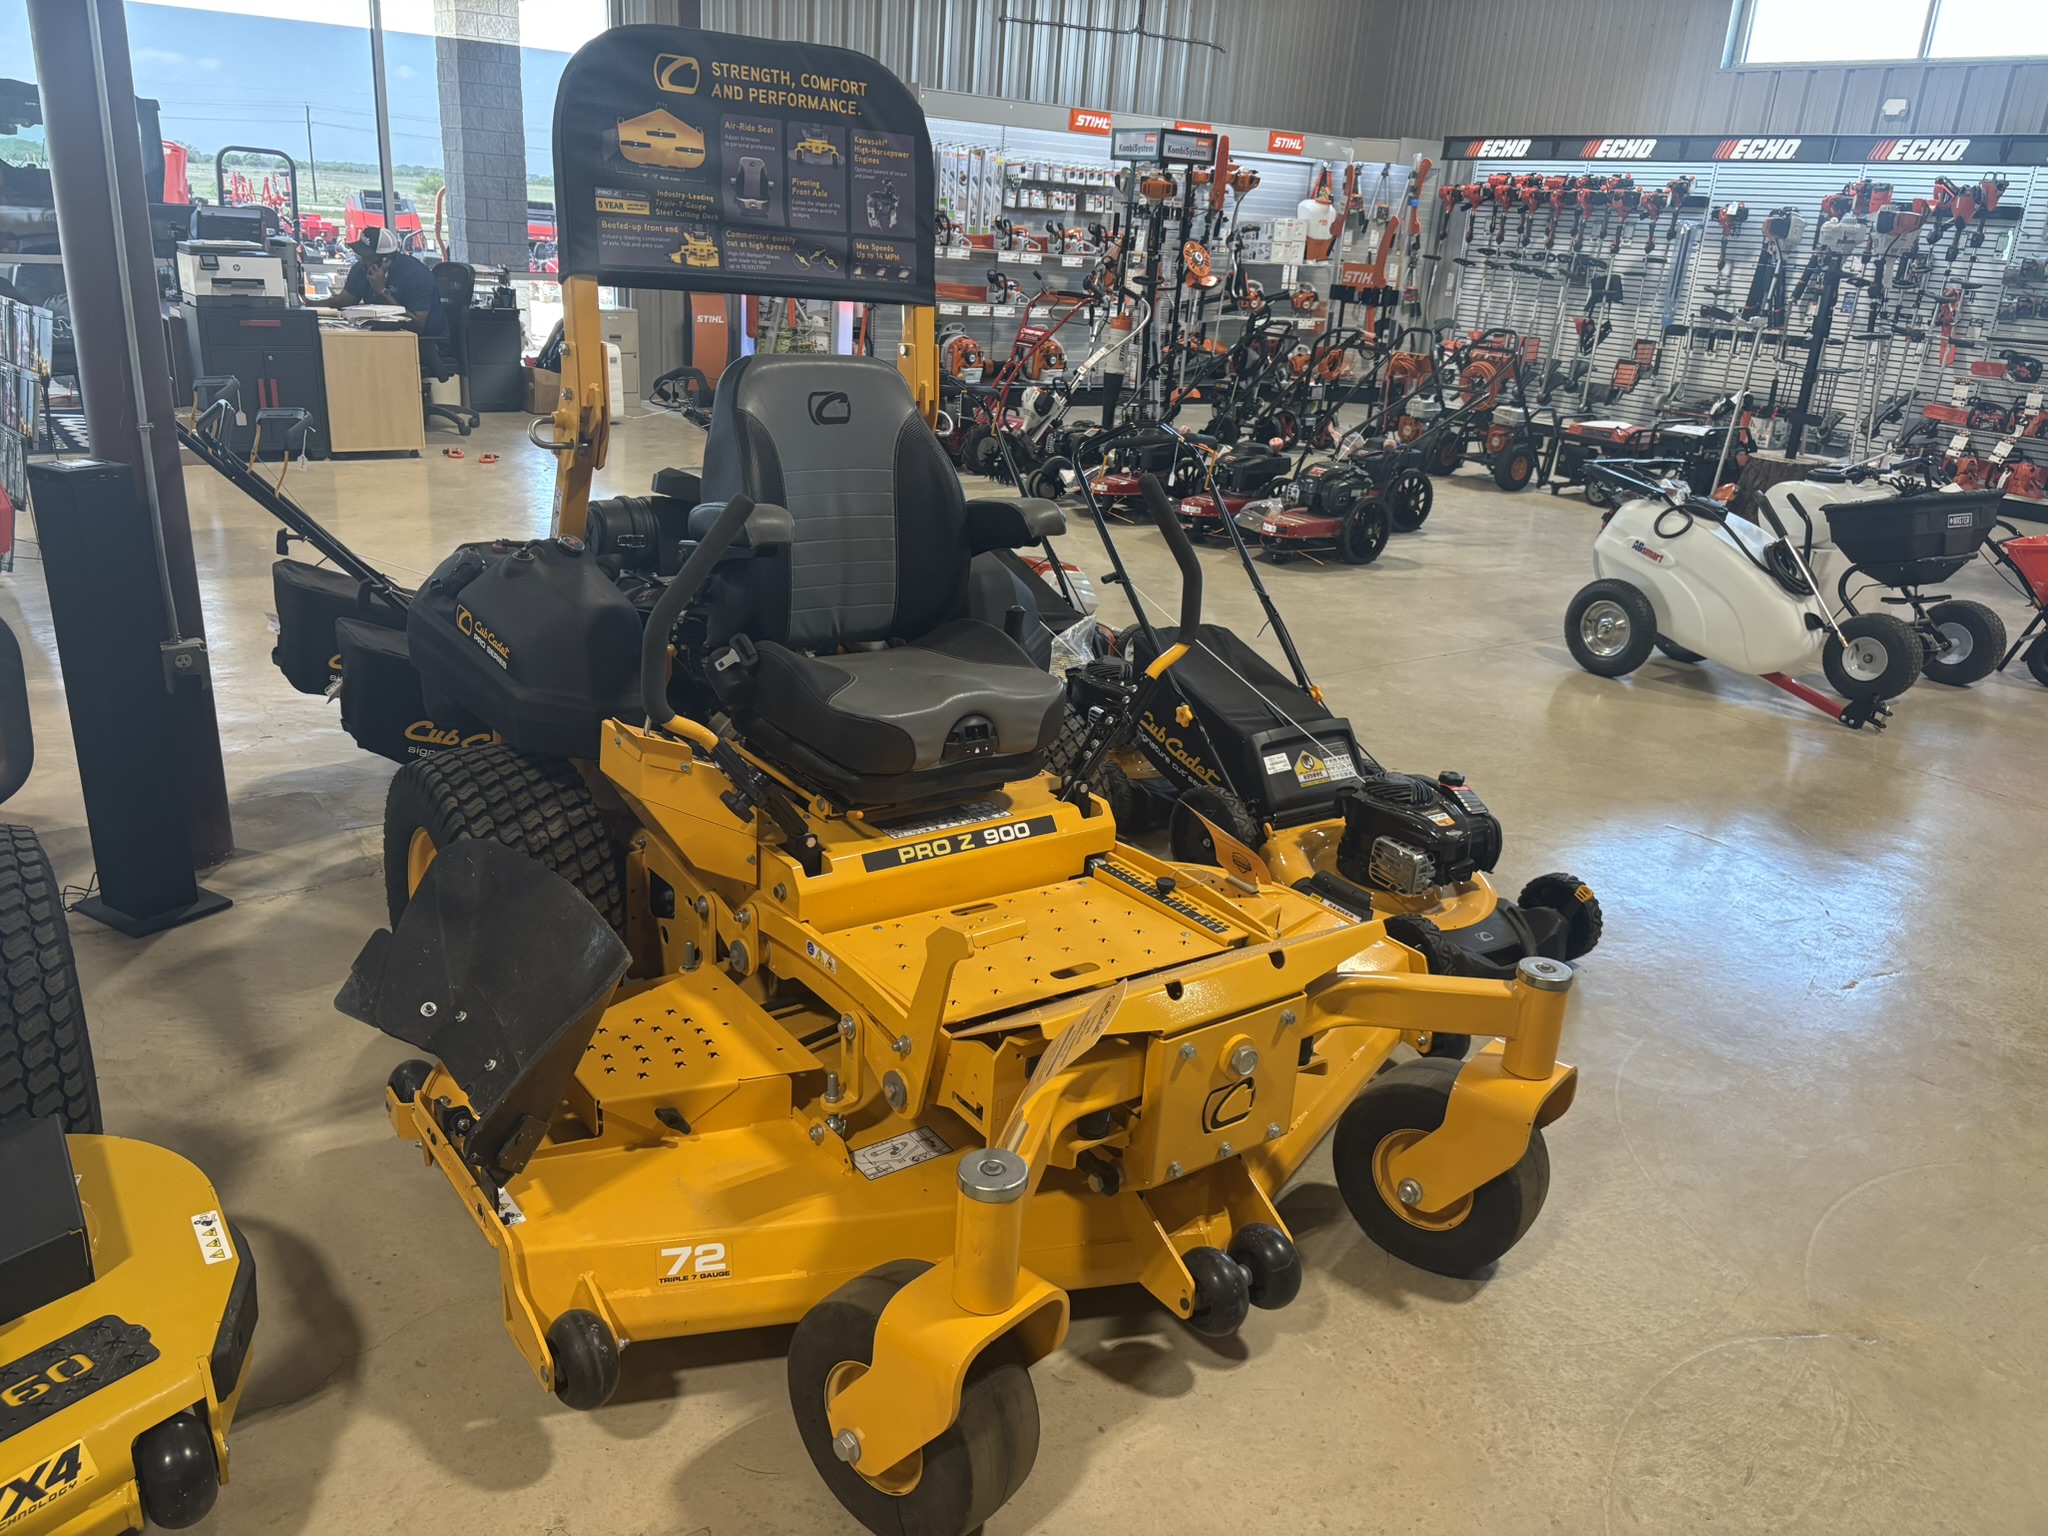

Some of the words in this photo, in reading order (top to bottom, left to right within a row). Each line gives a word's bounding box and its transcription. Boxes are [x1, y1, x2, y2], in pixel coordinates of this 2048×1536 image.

[711, 61, 796, 89] STRENGTH,
[800, 73, 868, 97] COMFORT
[711, 83, 744, 101] AND
[749, 87, 862, 116] PERFORMANCE.
[724, 121, 756, 132] Air-Ride
[757, 124, 774, 134] Seat
[1075, 114, 1111, 129] STIHL
[1118, 143, 1154, 154] KombiSystem
[1273, 135, 1304, 150] STIHL
[1477, 138, 1532, 158] ECHO
[1594, 138, 1658, 159] ECHO
[1729, 138, 1802, 160] ECHO
[1886, 138, 1971, 161] ECHO
[854, 145, 910, 159] High-Horsepower
[1167, 145, 1207, 157] KombiSystem
[854, 155, 880, 165] Engines
[791, 177, 821, 189] Pivoting
[657, 189, 714, 203] Industry-Leading
[791, 187, 811, 197] Front
[812, 188, 828, 198] Axle
[604, 200, 625, 210] YEAR
[655, 208, 673, 216] Steel
[674, 209, 700, 220] Cutting
[702, 211, 719, 220] Deck
[601, 220, 642, 233] Beefed-up
[644, 223, 664, 232] front
[665, 224, 679, 233] end
[725, 229, 797, 244] Commercial-quality
[726, 240, 738, 248] cut
[740, 240, 747, 248] at
[749, 241, 765, 251] high
[766, 243, 791, 252] speeds
[856, 242, 870, 250] Max
[871, 243, 895, 252] Speeds
[857, 251, 866, 260] Up
[884, 253, 900, 261] MPH
[1343, 270, 1374, 285] STIH
[696, 314, 725, 324] STIHL
[474, 620, 488, 640] Cub
[487, 632, 510, 659] Cadet
[473, 632, 486, 649] PRO
[486, 645, 508, 670] SERIES
[404, 720, 460, 746] Cub
[1165, 737, 1221, 787] Cadet
[898, 838, 951, 864] PRO
[957, 833, 975, 851] Z
[983, 822, 1031, 845] 900
[661, 1242, 727, 1276] 72
[659, 1275, 689, 1284] TRIPLE
[700, 1270, 731, 1280] GAUGE
[0, 1353, 96, 1407] 60
[0, 1442, 82, 1522] X4
